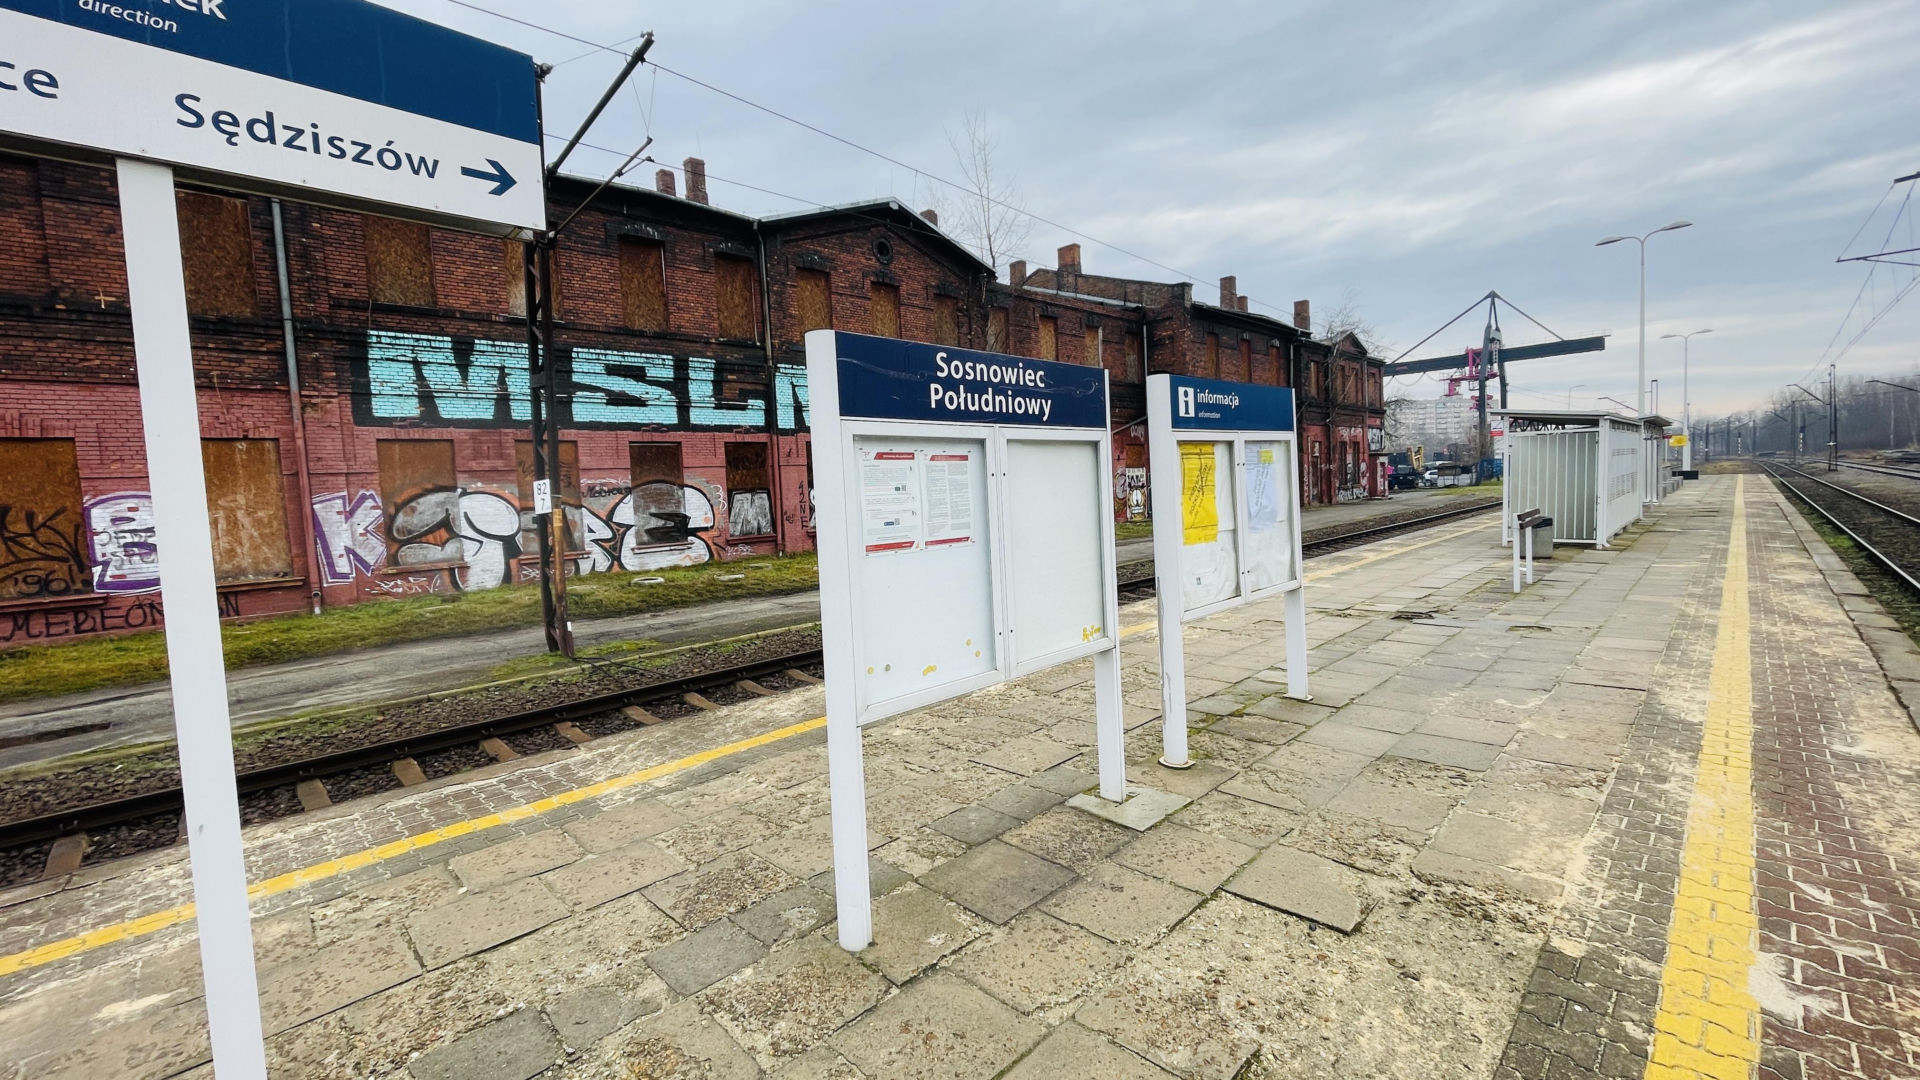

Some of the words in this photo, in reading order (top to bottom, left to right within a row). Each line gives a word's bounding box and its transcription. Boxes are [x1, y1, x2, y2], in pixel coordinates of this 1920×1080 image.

[78, 0, 178, 33] direction
[174, 92, 440, 179] Sędziszów
[935, 351, 1046, 388] Sosnowiec
[929, 383, 1052, 422] Południowy
[1197, 389, 1240, 409] informacja
[536, 482, 548, 496] 82
[541, 498, 546, 511] 7
